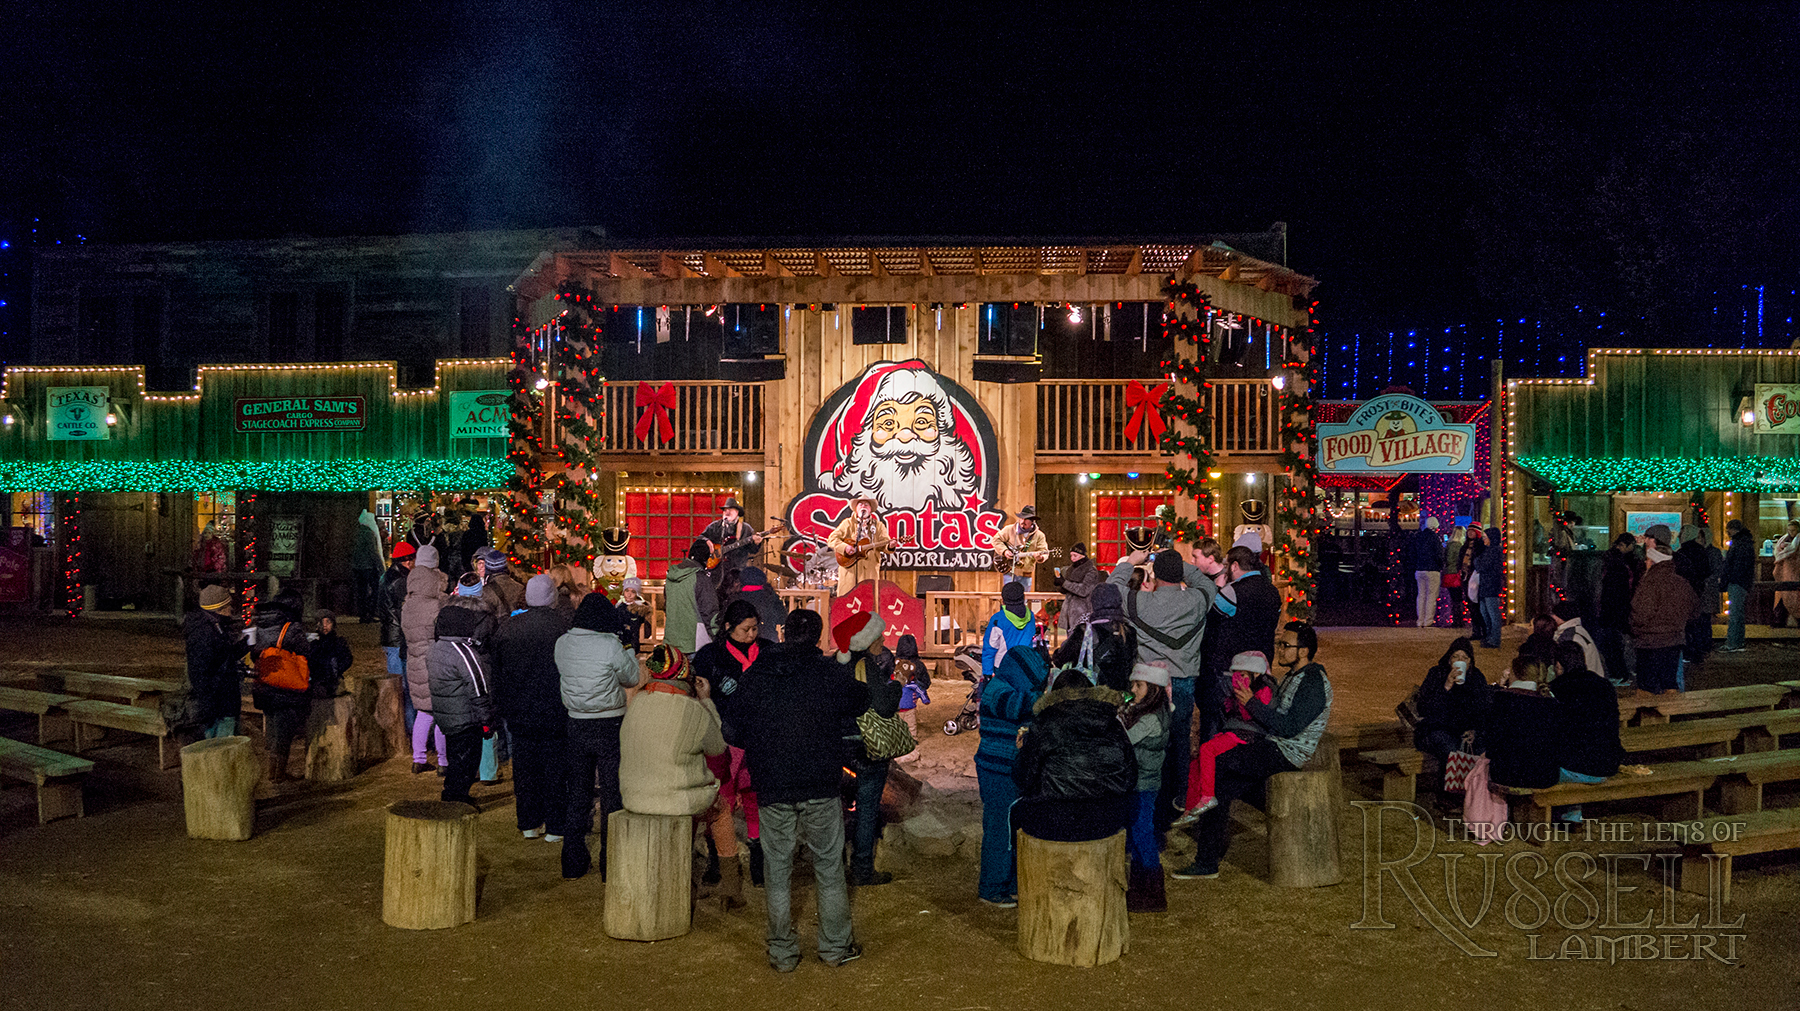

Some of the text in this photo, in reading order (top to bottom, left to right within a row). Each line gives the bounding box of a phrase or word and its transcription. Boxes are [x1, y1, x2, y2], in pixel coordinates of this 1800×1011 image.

[57, 391, 99, 405] TEXAS
[242, 400, 358, 416] GENERAL SAM'S
[460, 407, 509, 423] ACM
[1355, 400, 1390, 426] FROST
[1400, 400, 1436, 425] BITE'S
[242, 419, 298, 429] STAGECOACH
[299, 419, 334, 428] EXPRESS
[1325, 432, 1463, 463] FOOD VILLAGE
[880, 551, 992, 568] NDERLAND
